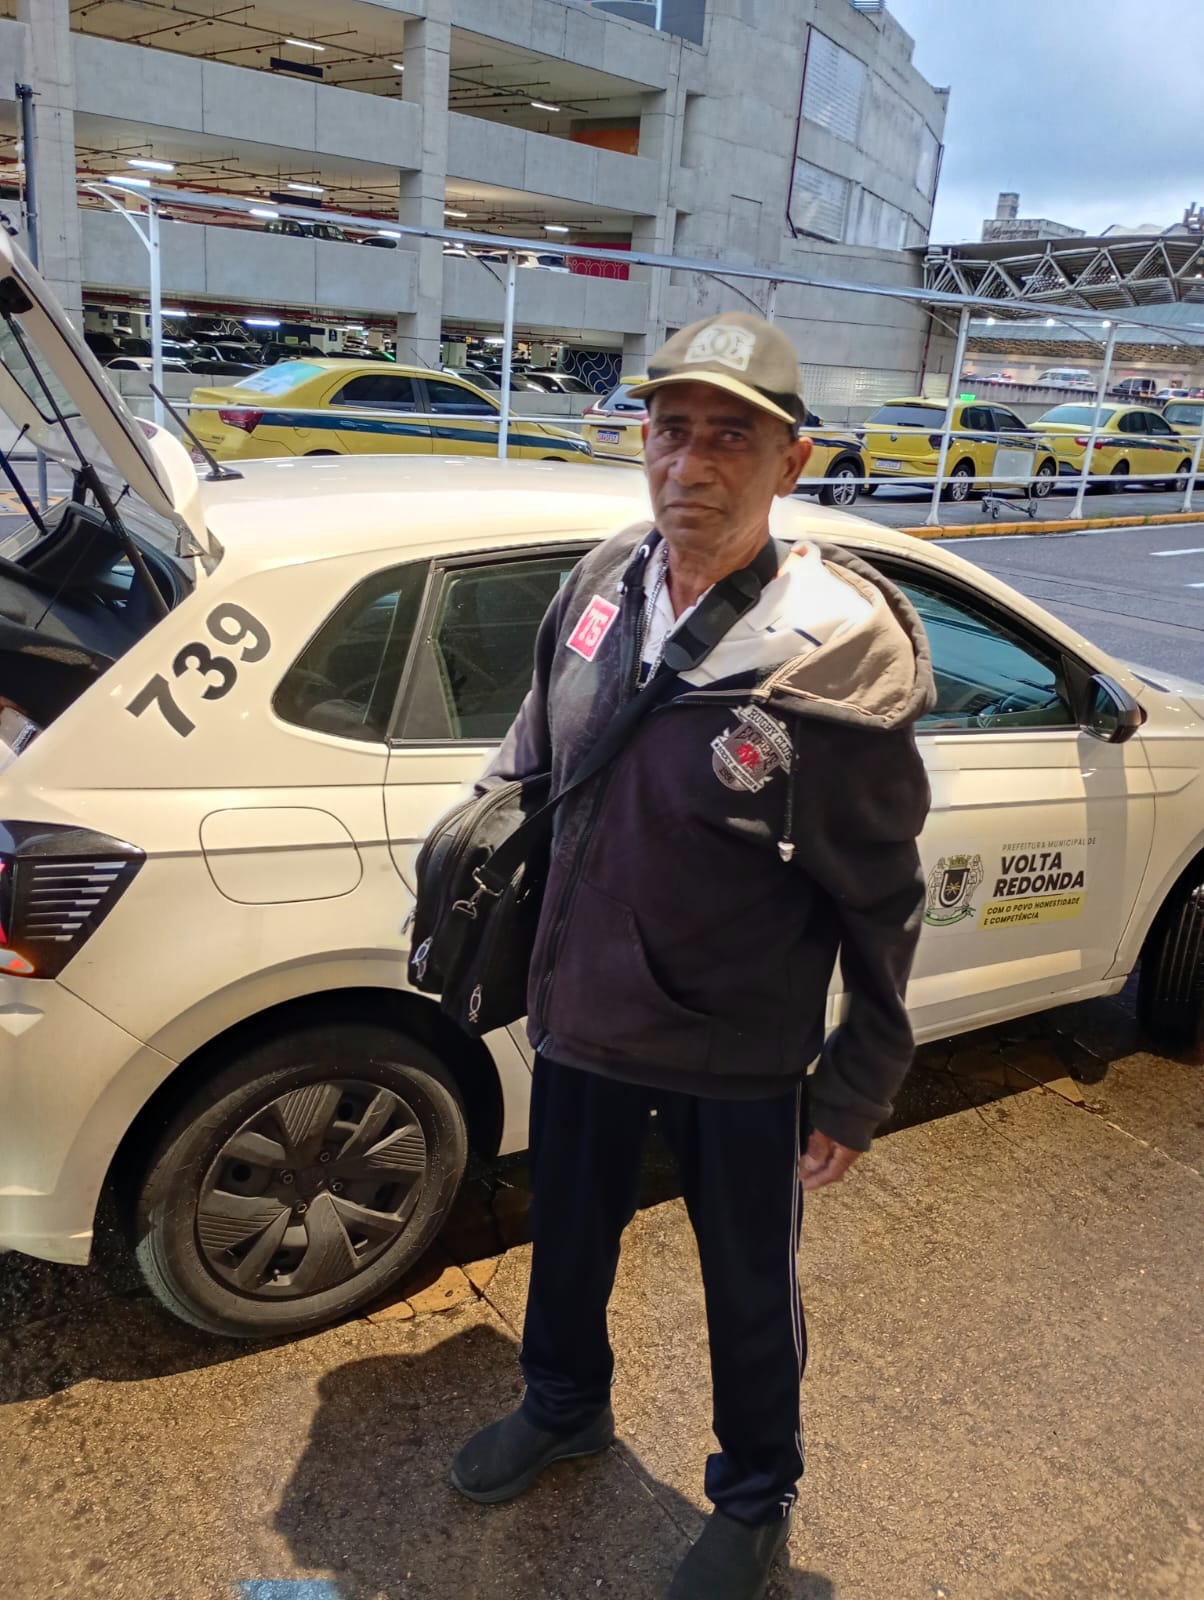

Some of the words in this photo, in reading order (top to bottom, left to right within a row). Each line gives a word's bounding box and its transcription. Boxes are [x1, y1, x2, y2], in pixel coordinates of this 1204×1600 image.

[125, 602, 272, 738] 739
[747, 708, 778, 738] RUGBY
[774, 735, 793, 761] CLUB
[1002, 841, 1046, 851] PREFEITURA
[1047, 838, 1086, 848] MUNICIPAL
[1087, 837, 1097, 845] DE
[1001, 852, 1062, 875] VOLTA
[993, 870, 1085, 897] REDONDA
[987, 906, 1004, 915] COM
[1012, 903, 1033, 912] POVO
[1034, 897, 1080, 909] HONESTIDADE
[990, 912, 1039, 925] COMPETÊNCIA
